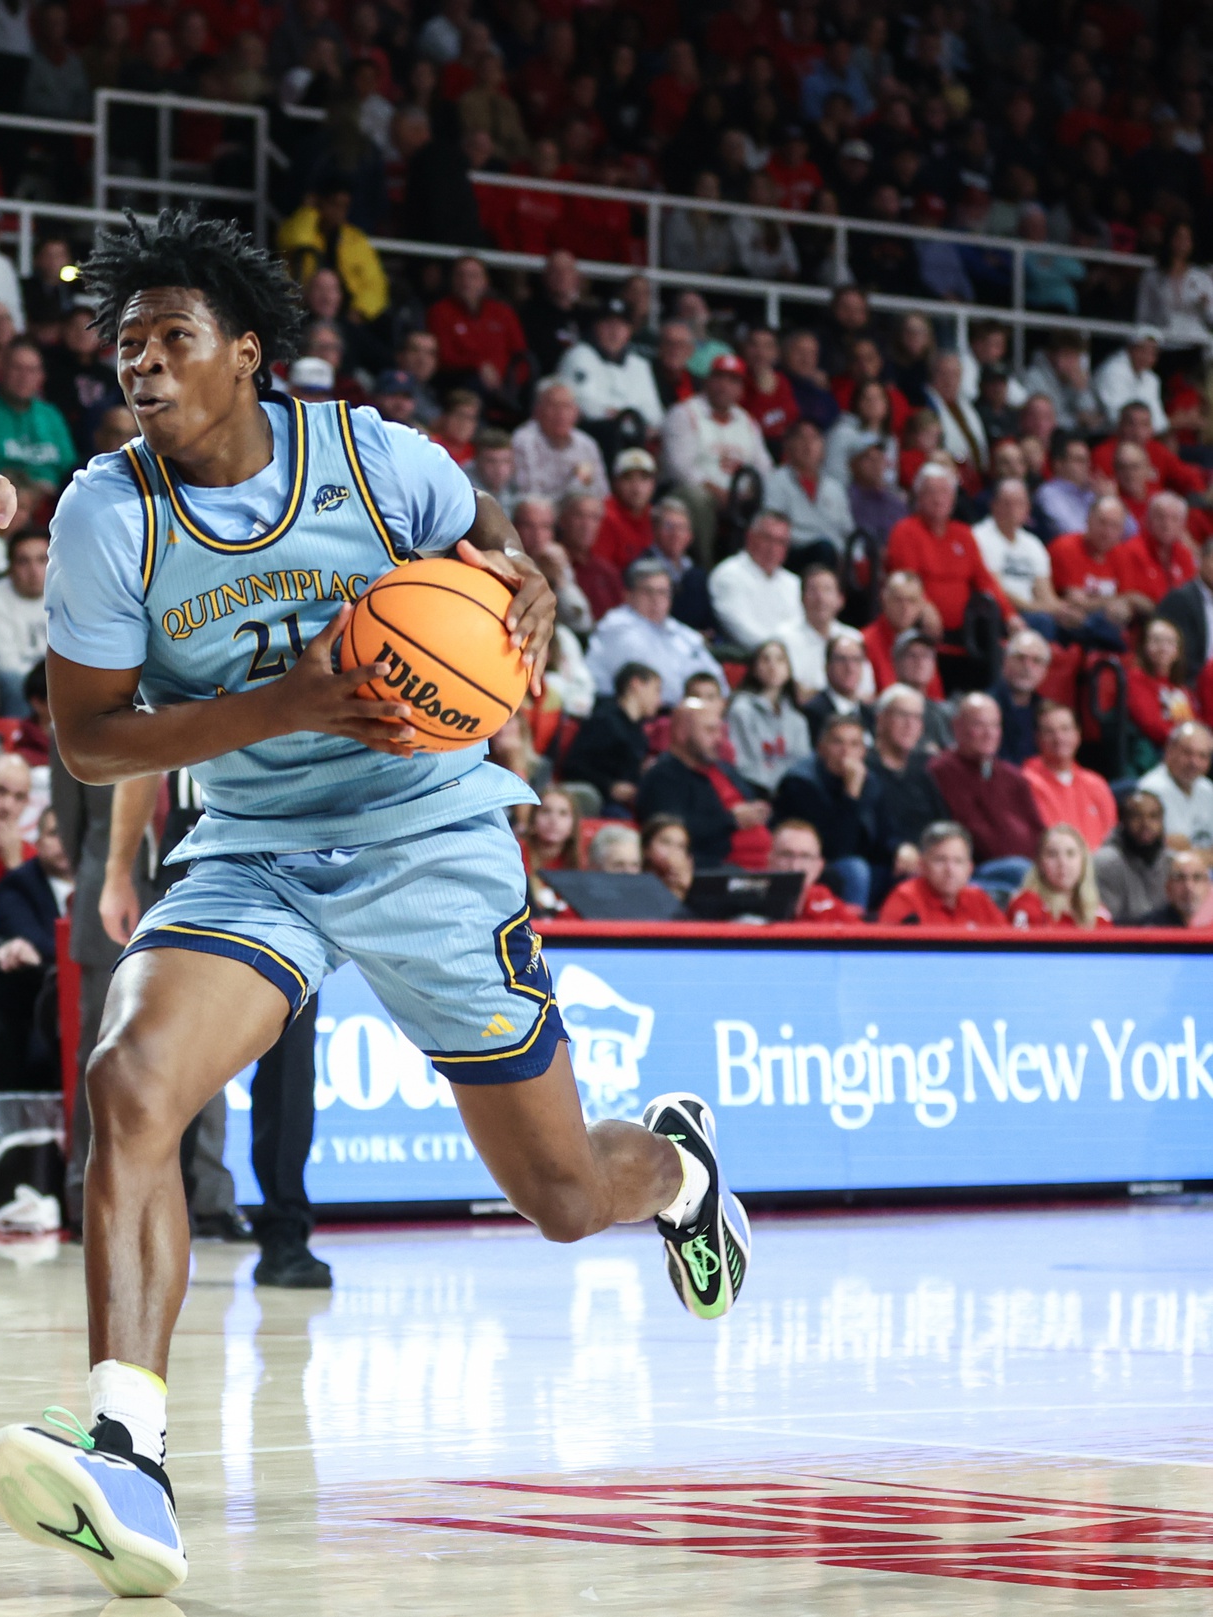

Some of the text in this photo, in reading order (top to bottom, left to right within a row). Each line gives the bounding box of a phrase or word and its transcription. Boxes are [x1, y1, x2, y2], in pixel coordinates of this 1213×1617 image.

[162, 569, 368, 641] QUINNIPIAC
[233, 612, 304, 684] 21
[374, 641, 480, 733] Wilson
[714, 1016, 1213, 1129] Bringing New York
[330, 1133, 408, 1164] YORK
[412, 1133, 477, 1163] CITY
